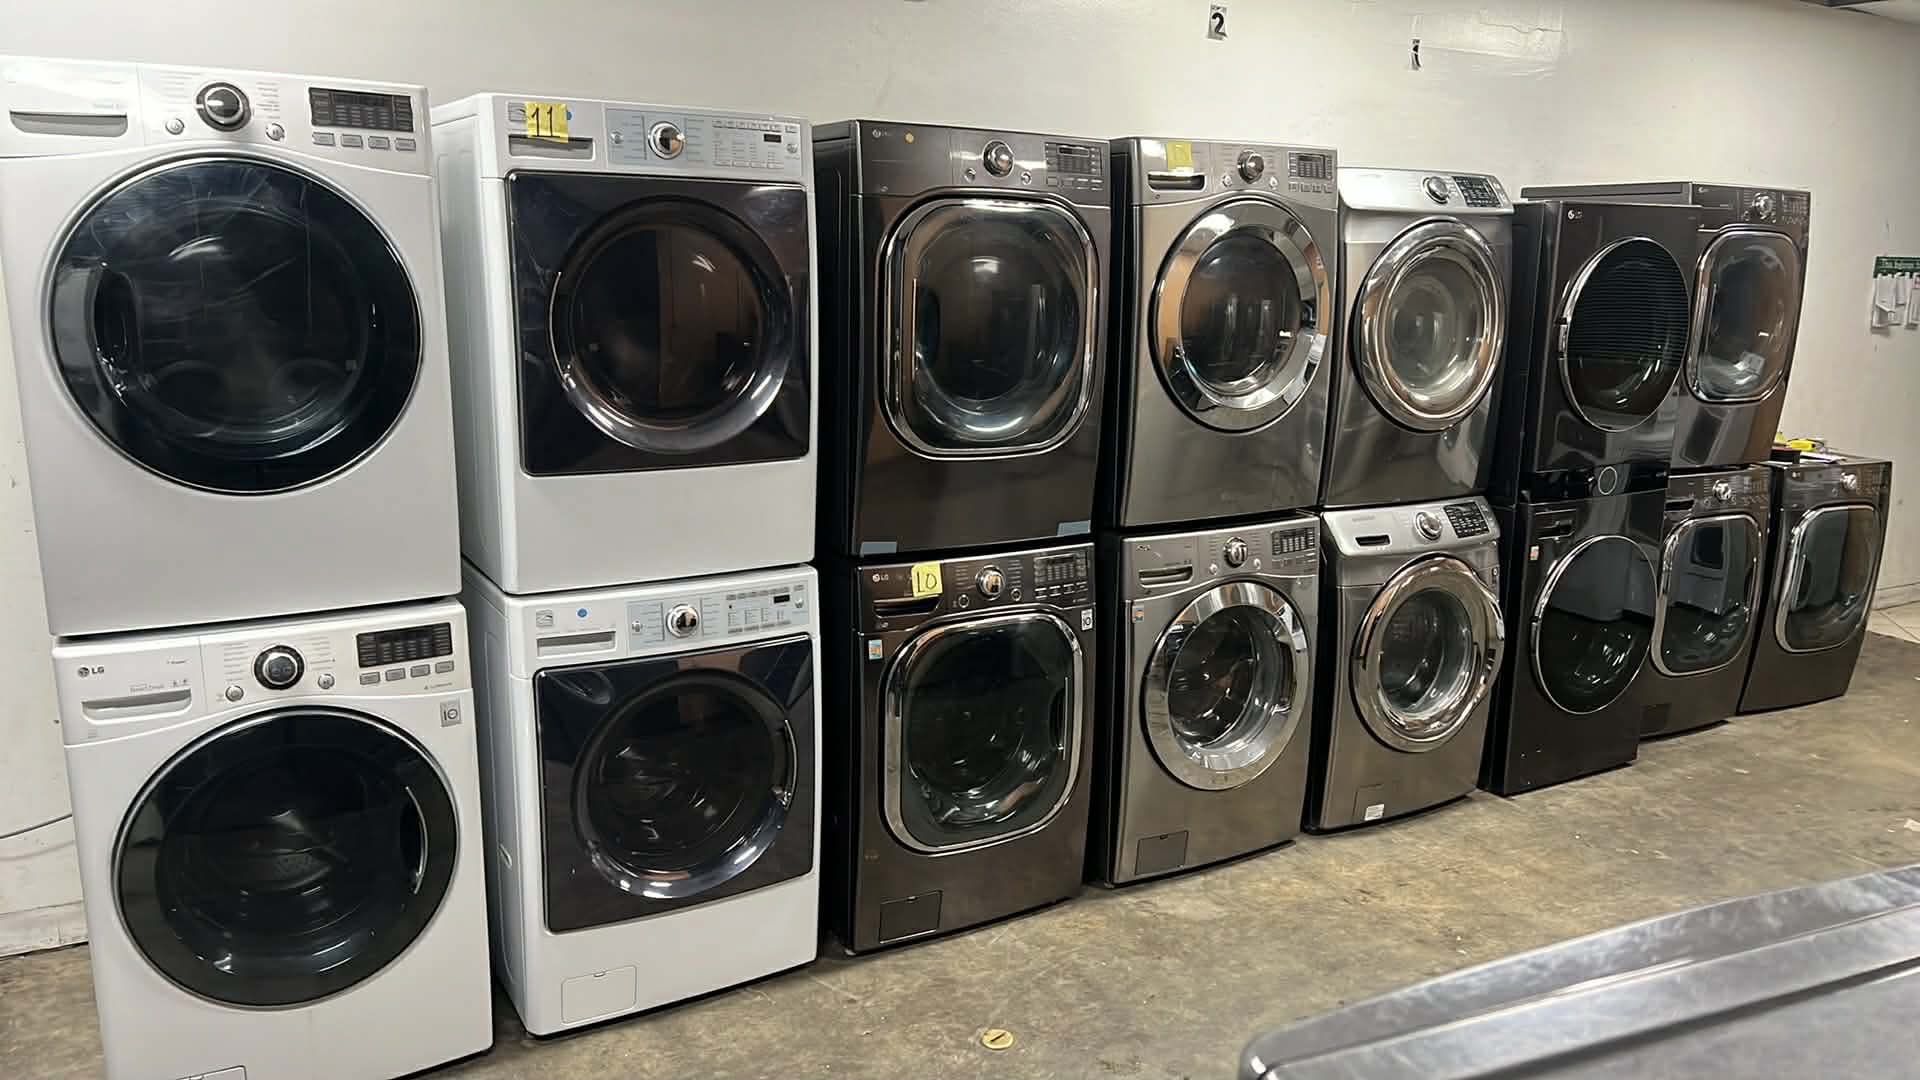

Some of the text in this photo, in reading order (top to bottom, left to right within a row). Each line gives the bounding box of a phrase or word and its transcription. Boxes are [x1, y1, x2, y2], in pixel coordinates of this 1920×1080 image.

[1211, 12, 1227, 37] 2
[531, 106, 560, 137] 11
[916, 571, 938, 593] 10
[91, 665, 105, 675] LG
